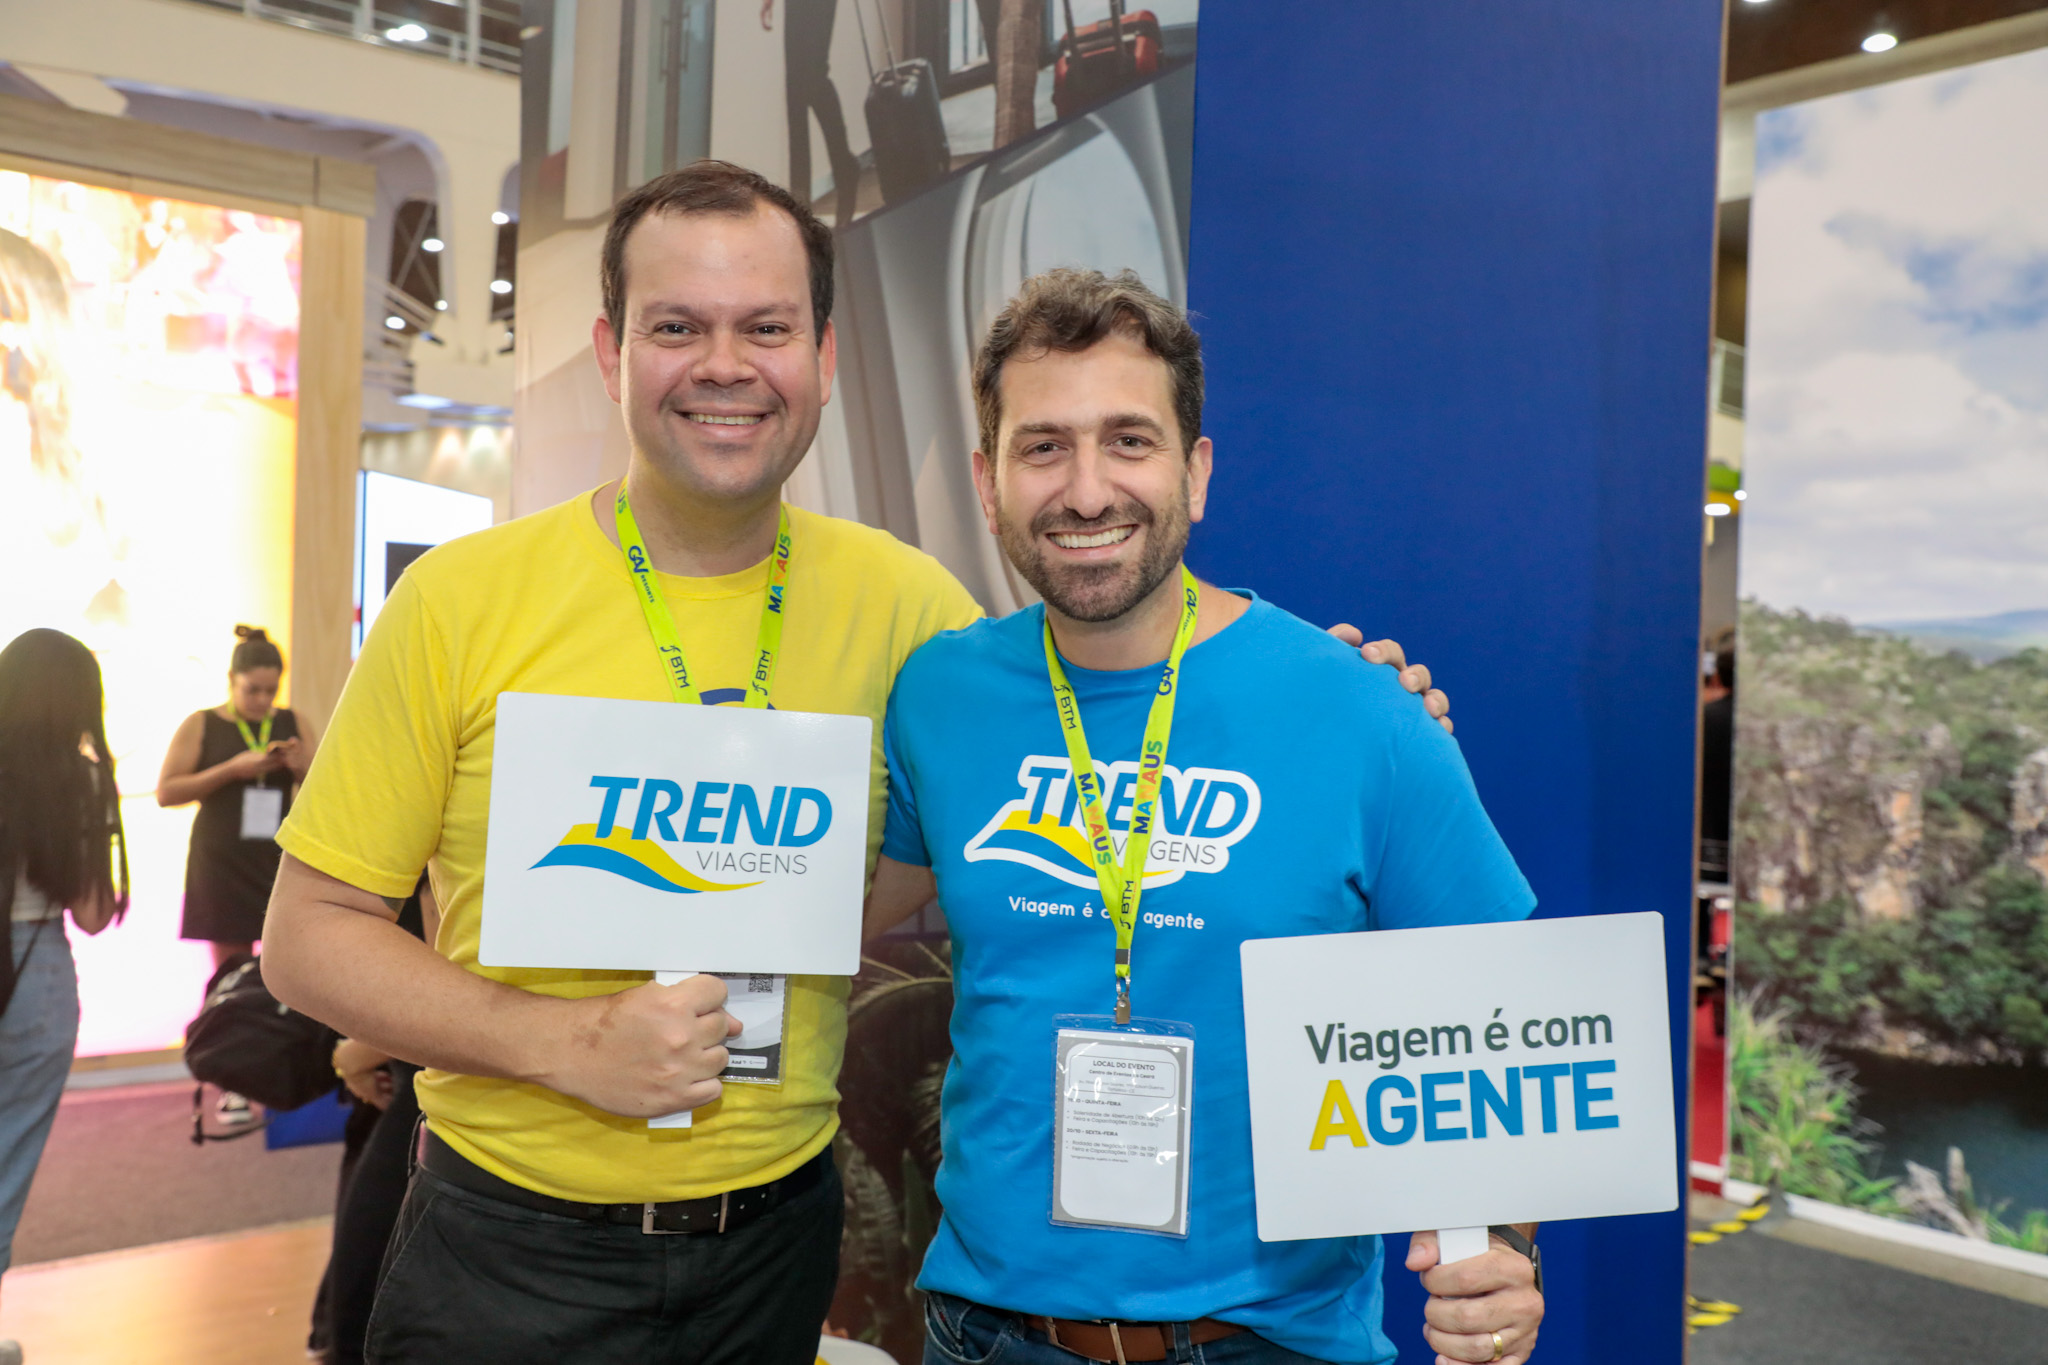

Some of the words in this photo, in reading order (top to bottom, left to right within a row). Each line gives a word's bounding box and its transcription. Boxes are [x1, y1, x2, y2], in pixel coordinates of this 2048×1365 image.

[768, 533, 792, 614] MANAUS
[670, 656, 690, 688] BTM
[755, 649, 771, 681] BTM
[1060, 696, 1077, 730] BTM
[1133, 740, 1163, 834] MANAUS
[589, 775, 833, 848] TREND
[1078, 772, 1112, 866] MANAUS
[696, 850, 807, 875] VIAGENS
[1112, 836, 1217, 865] VGENS
[1009, 896, 1075, 918] Viagem
[1082, 902, 1094, 918] é
[1143, 912, 1205, 930] agente
[1121, 880, 1134, 914] BTM
[1304, 1022, 1473, 1070] Viagem
[1484, 1008, 1509, 1051] é
[1521, 1013, 1613, 1049] com
[1093, 1060, 1115, 1068] LOCAL
[1128, 1062, 1155, 1071] EVENTO
[1085, 1098, 1121, 1106] QUINTA-FEIRA
[1309, 1059, 1619, 1151] AGENTE
